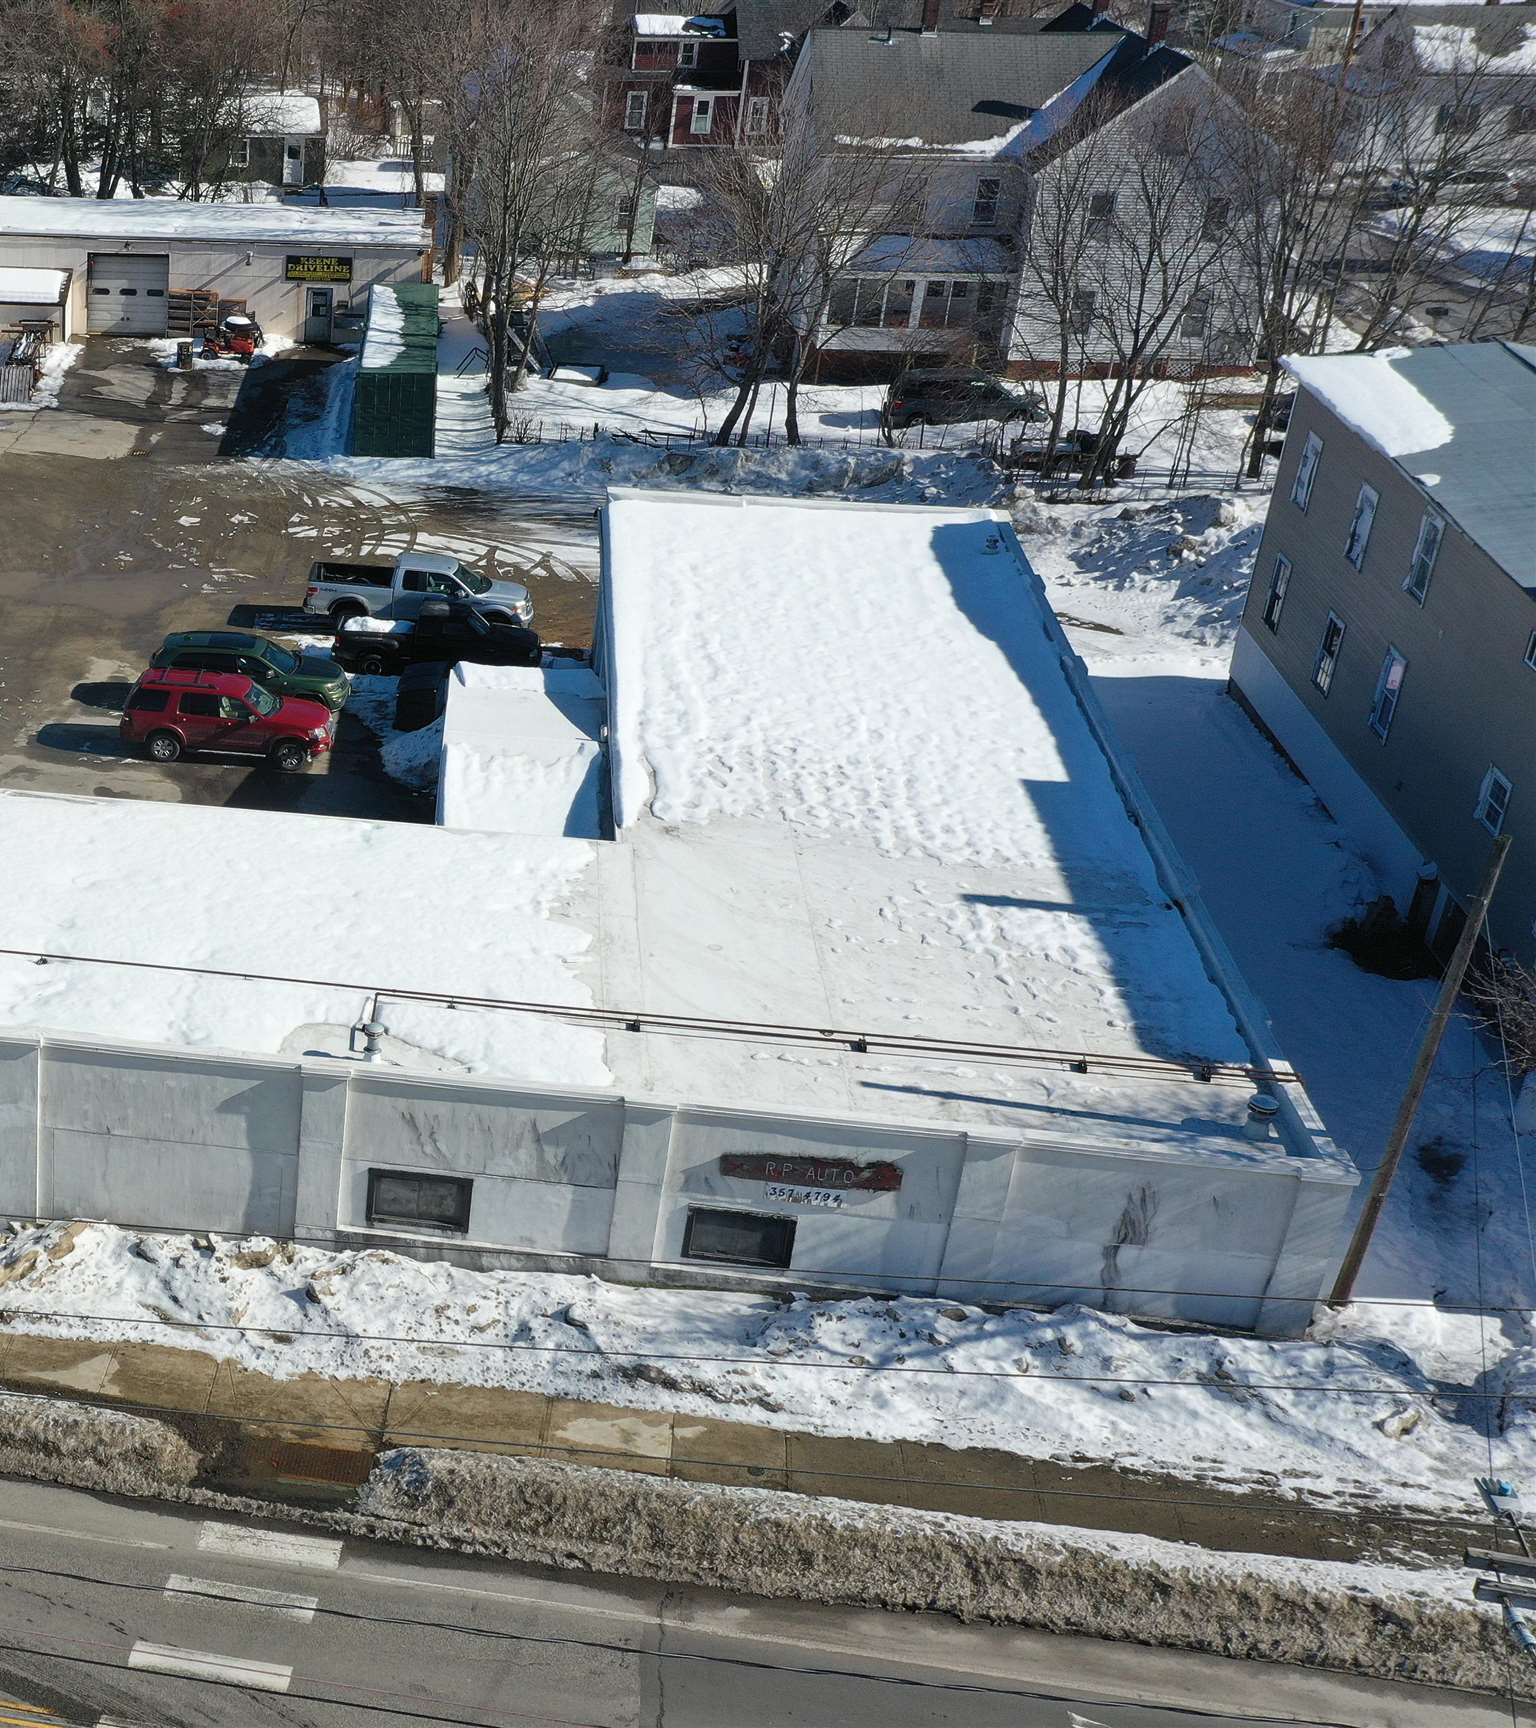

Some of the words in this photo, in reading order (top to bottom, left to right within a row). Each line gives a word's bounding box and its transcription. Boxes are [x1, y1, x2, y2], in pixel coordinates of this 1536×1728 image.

[300, 257, 339, 265] KEENE
[288, 264, 351, 273] DRIVELINE
[805, 1167, 854, 1184] AUTO
